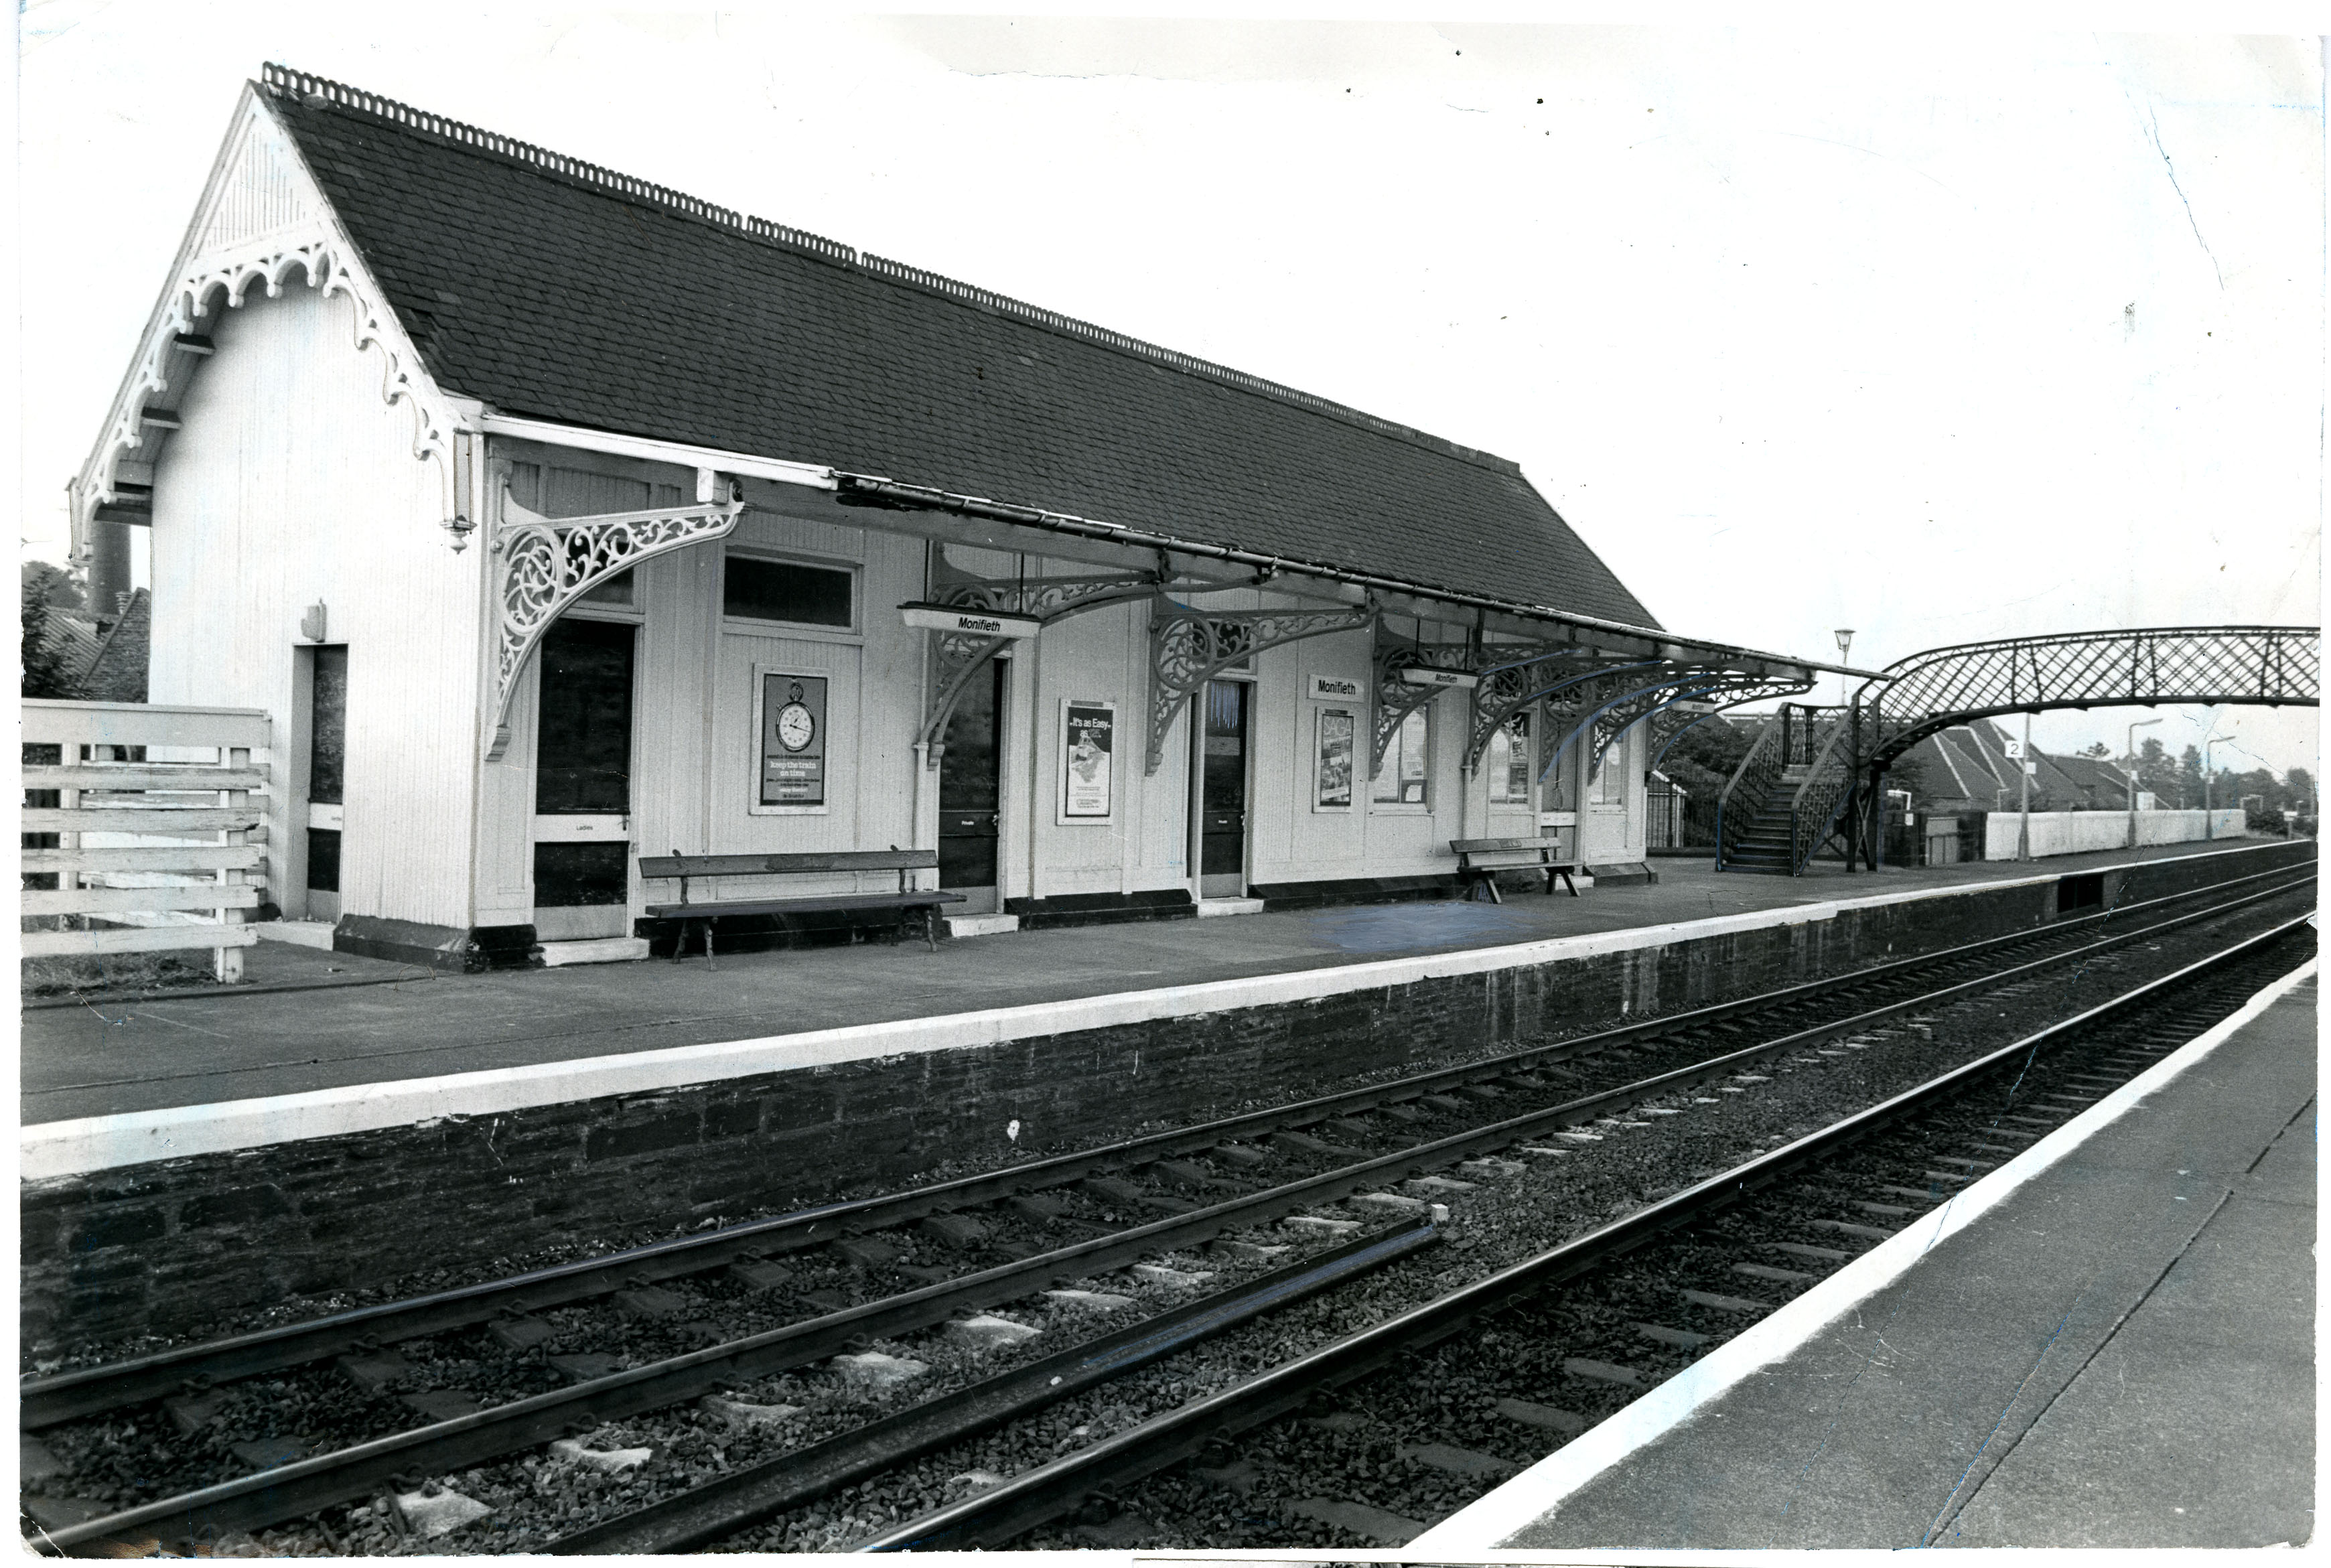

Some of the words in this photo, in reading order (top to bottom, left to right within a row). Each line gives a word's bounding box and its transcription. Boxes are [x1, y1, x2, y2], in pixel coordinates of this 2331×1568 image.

[958, 617, 1001, 632] Monifieth
[1318, 679, 1356, 695] Monifieth
[1083, 719, 1092, 727] as
[1323, 717, 1352, 736] SAGA
[2010, 743, 2019, 755] 2
[770, 761, 787, 770] keep
[787, 761, 799, 769] the
[798, 762, 817, 770] train
[790, 769, 806, 777] time
